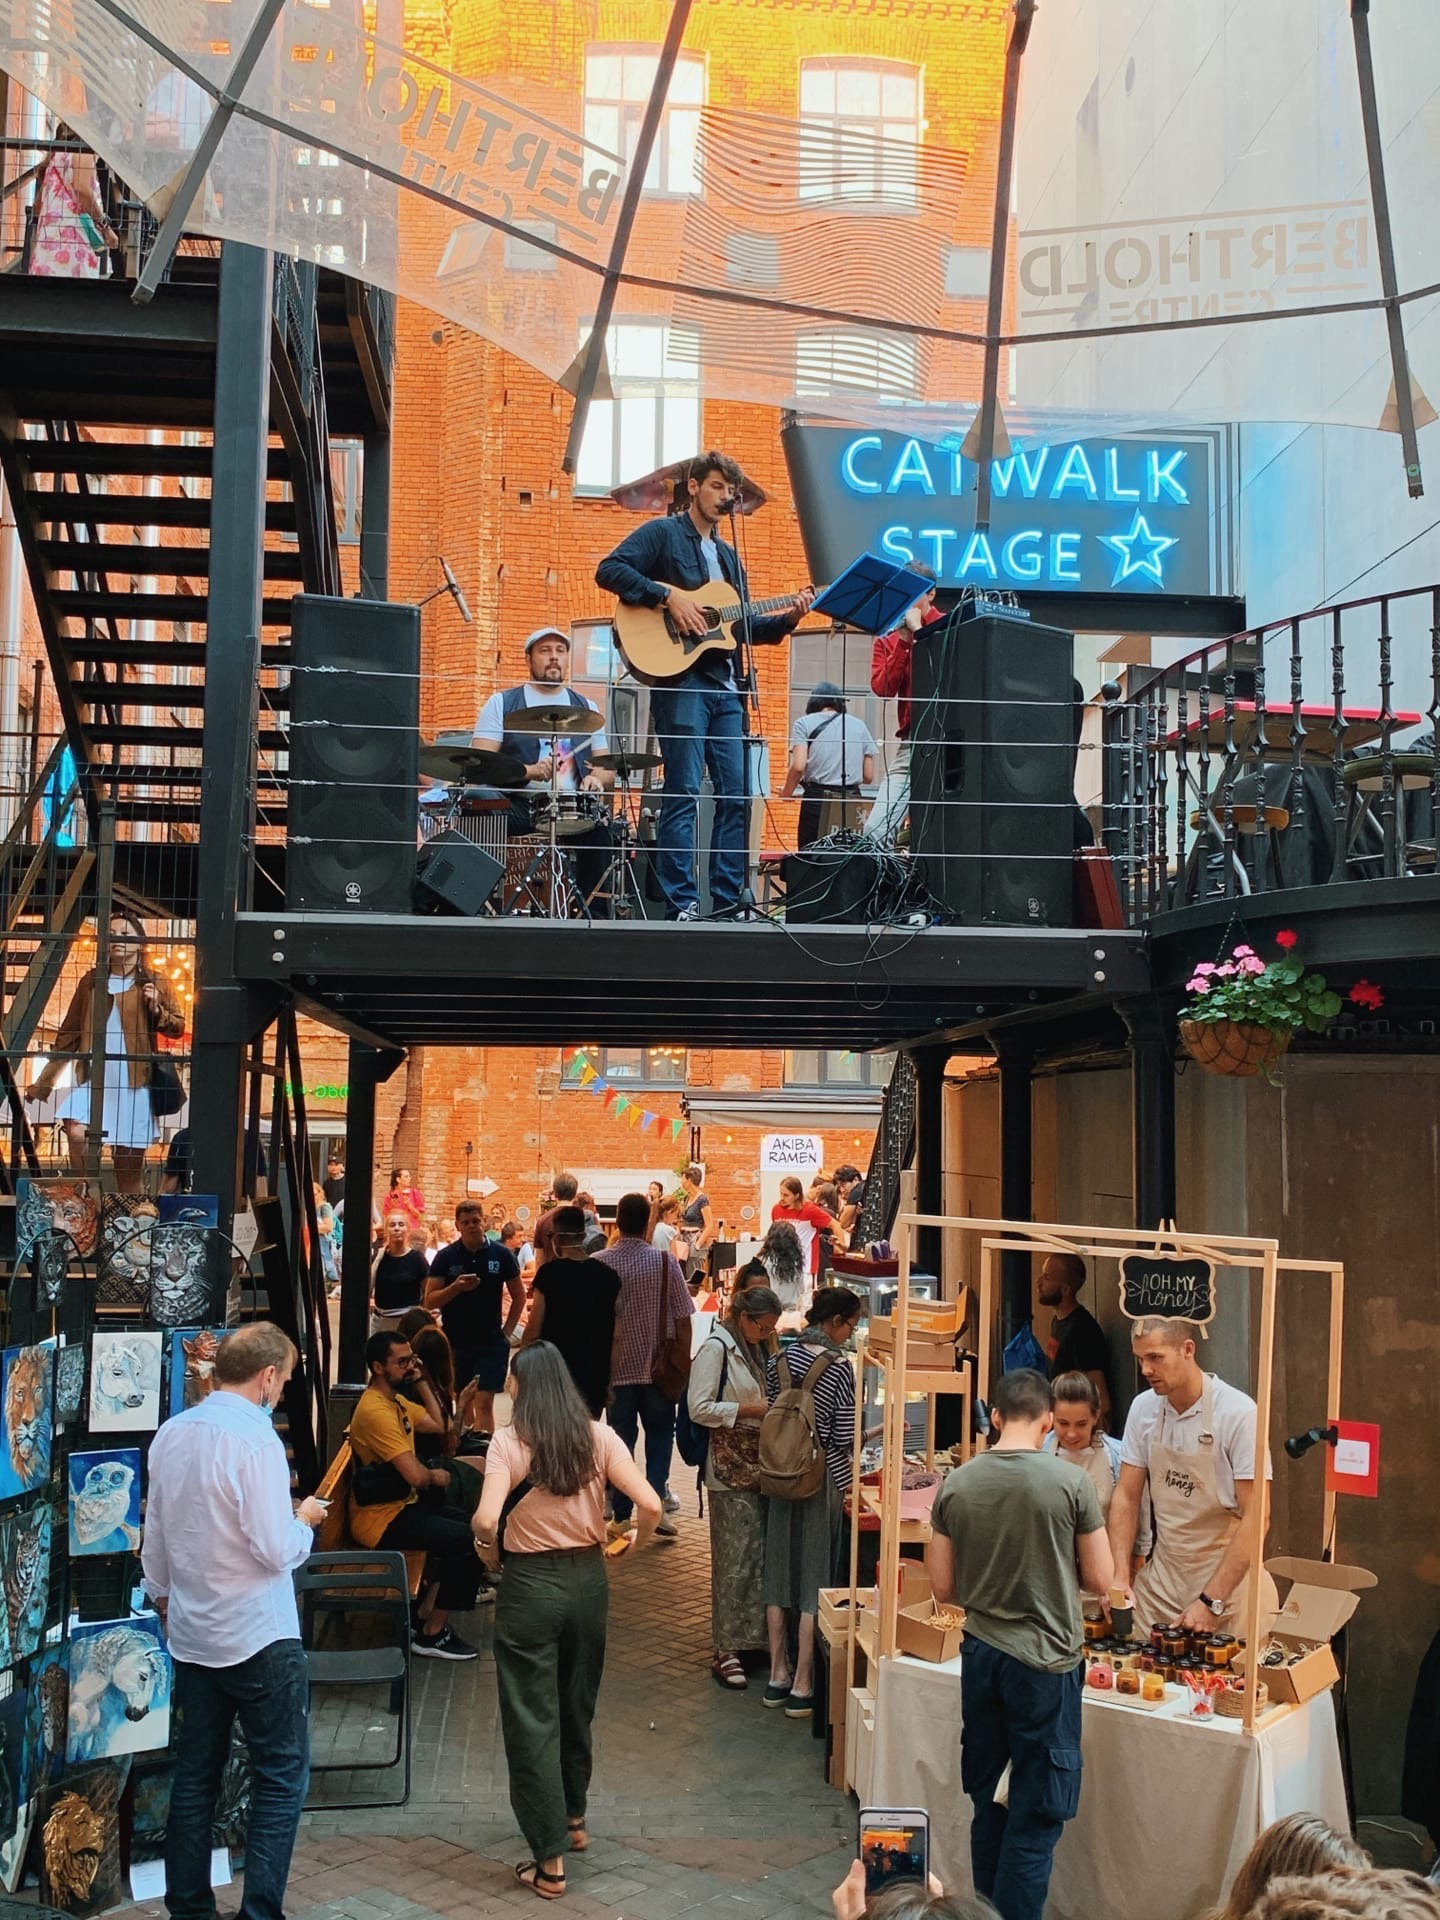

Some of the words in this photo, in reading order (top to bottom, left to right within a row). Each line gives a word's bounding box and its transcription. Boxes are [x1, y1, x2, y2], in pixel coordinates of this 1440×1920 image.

[841, 436, 1191, 505] CATWALK
[881, 525, 1082, 582] STAGE
[768, 1151, 817, 1164] RAMEN
[772, 1138, 814, 1150] AKIBA
[488, 1260, 501, 1270] 83
[1139, 1273, 1206, 1317] honey
[1165, 1469, 1196, 1498] honey
